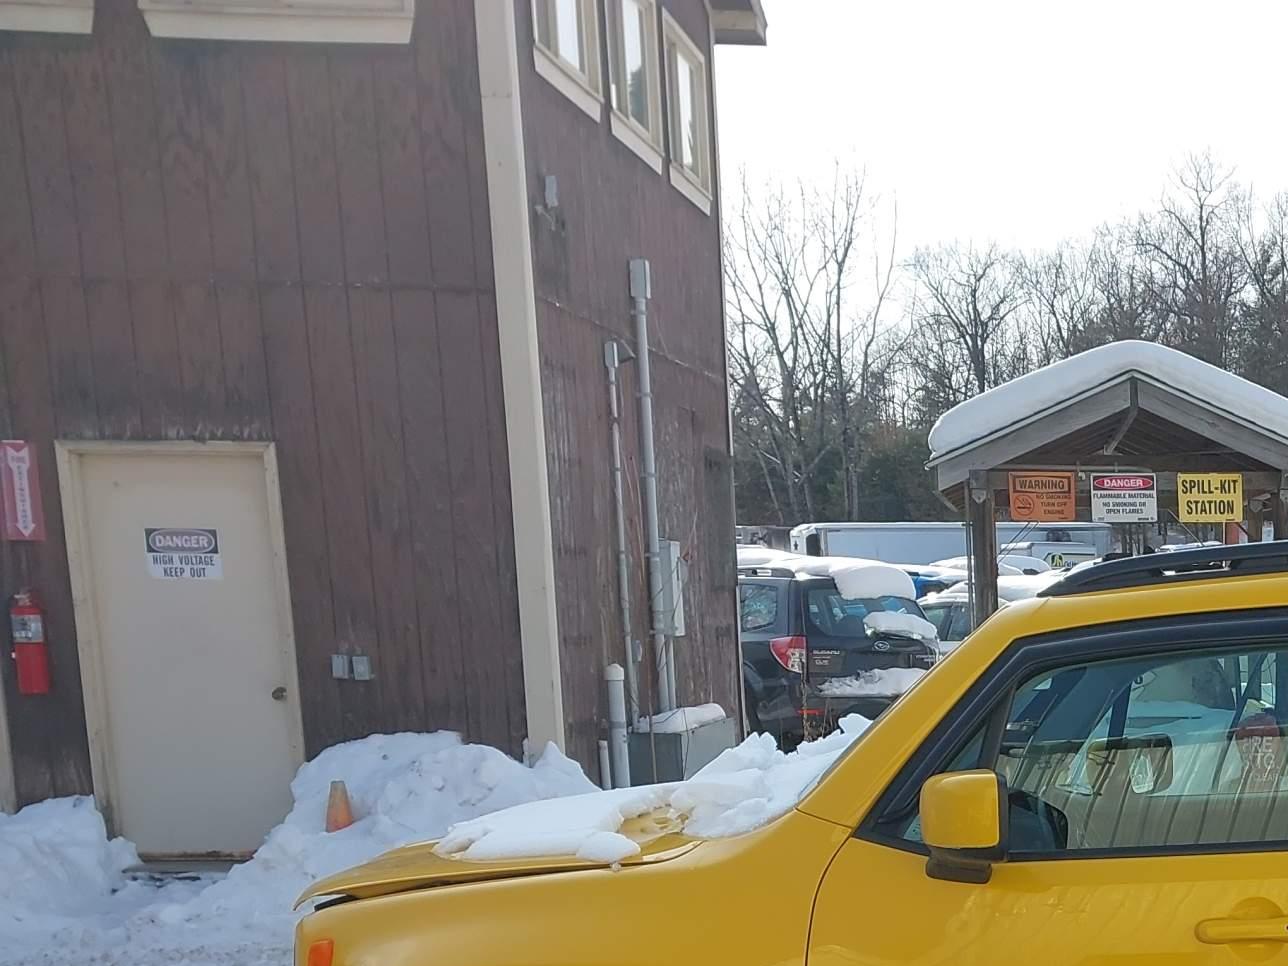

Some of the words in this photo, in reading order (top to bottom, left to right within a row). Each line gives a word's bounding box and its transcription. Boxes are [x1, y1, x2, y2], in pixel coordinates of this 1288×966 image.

[1018, 479, 1065, 490] WARNING
[1103, 479, 1144, 487] DANGER
[1181, 479, 1239, 494] SPILL-KIT
[1186, 500, 1235, 515] STATION
[155, 535, 209, 547] DANGER
[152, 554, 174, 566] HIGH
[178, 554, 215, 566] VOLTAGE
[163, 567, 185, 577] KEEP
[189, 567, 206, 578] OUT
